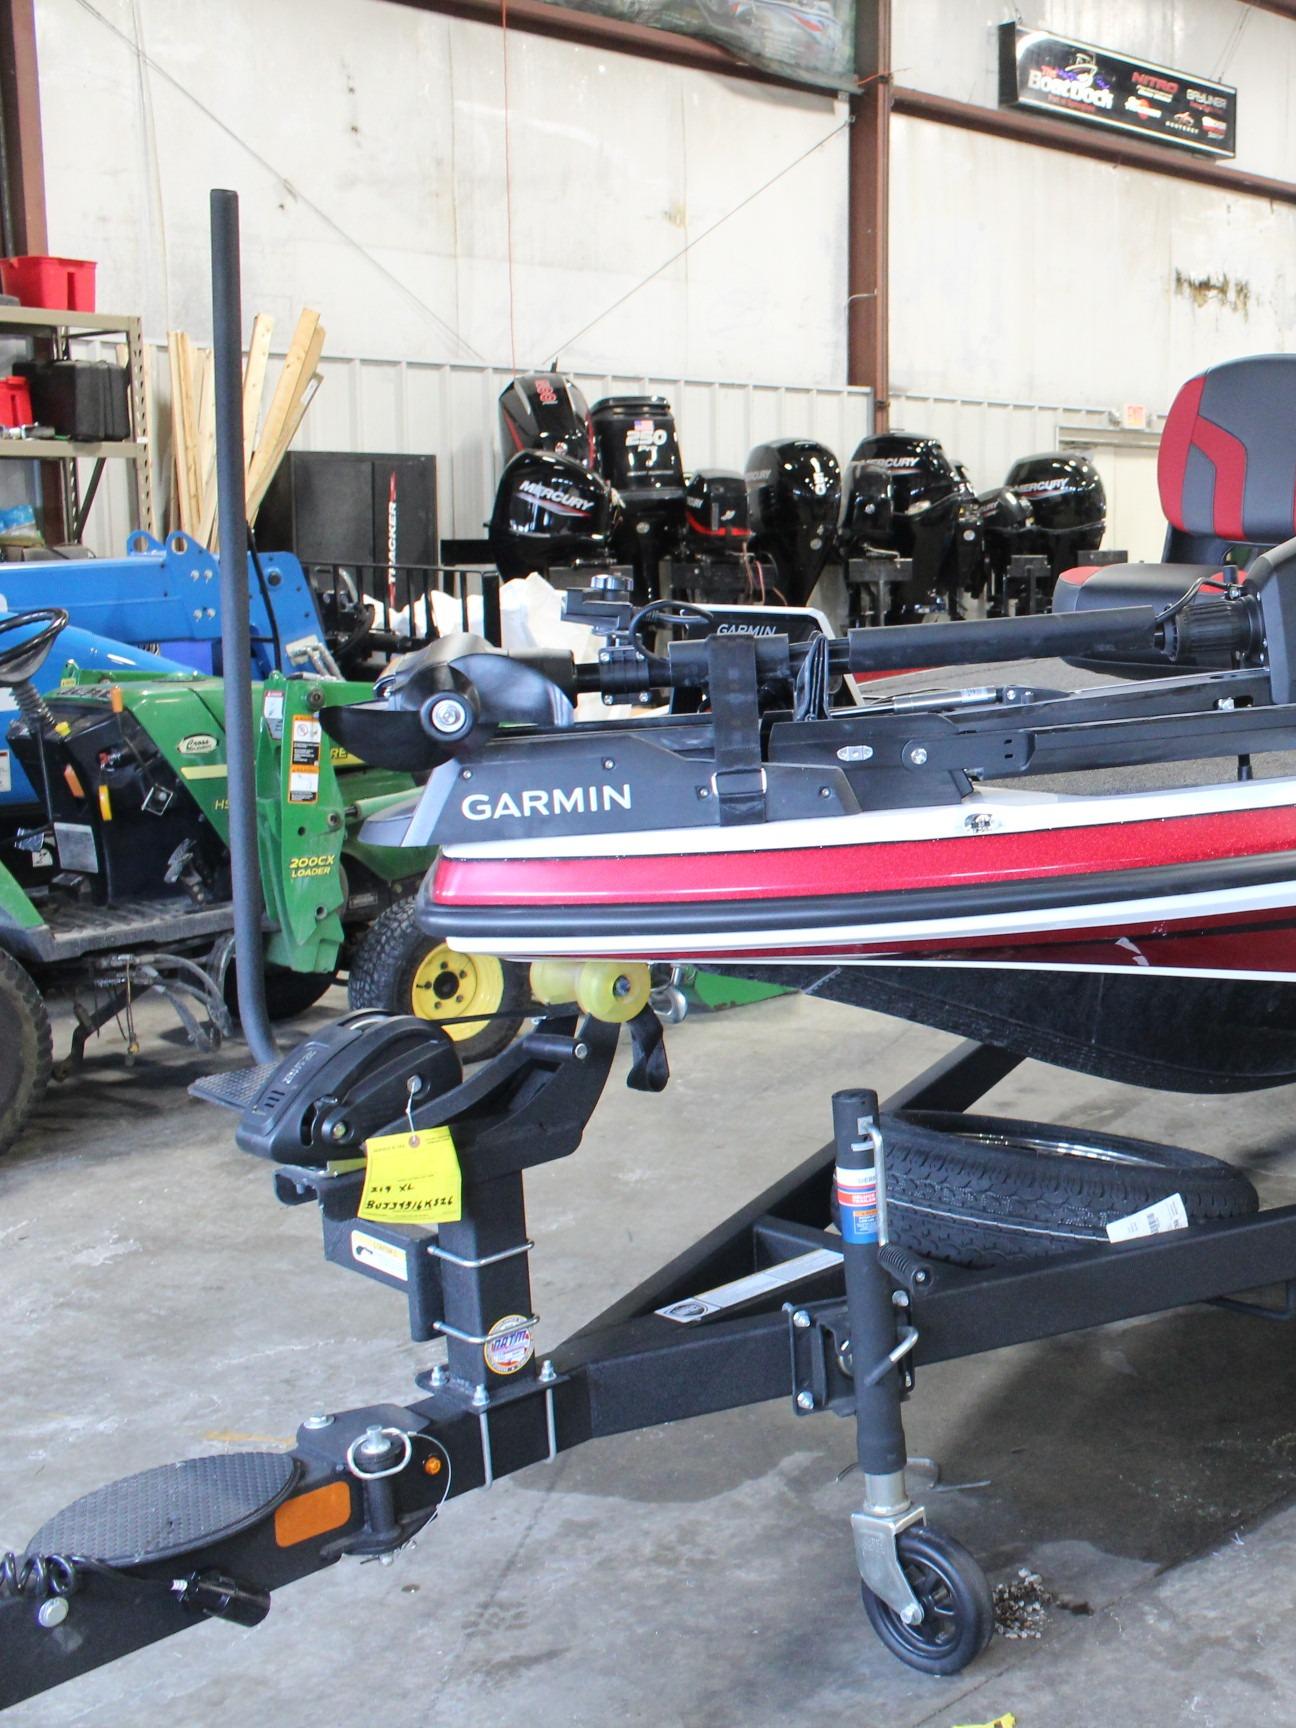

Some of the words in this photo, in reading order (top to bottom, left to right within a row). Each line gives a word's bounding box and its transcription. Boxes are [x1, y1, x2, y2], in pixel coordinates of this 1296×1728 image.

[519, 480, 595, 511] MERCURY
[716, 623, 777, 637] GARMIN
[461, 783, 632, 821] GARMIN
[289, 855, 336, 868] 200CX
[291, 866, 331, 878] LOADER
